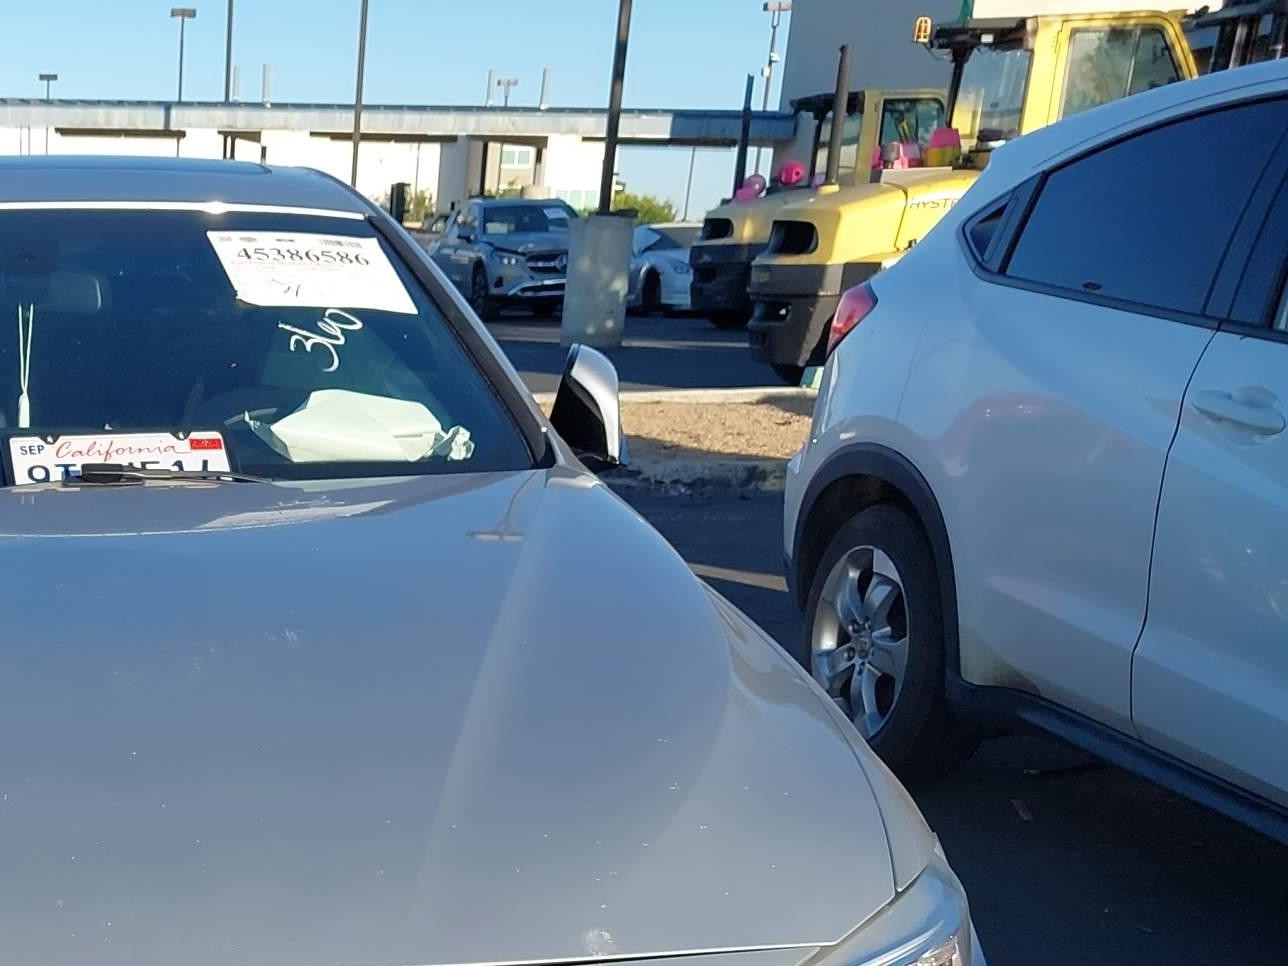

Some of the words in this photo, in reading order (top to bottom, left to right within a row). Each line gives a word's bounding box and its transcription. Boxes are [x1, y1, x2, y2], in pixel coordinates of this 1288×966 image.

[237, 247, 369, 266] 45386586
[20, 445, 45, 456] SEP
[55, 440, 191, 462] California
